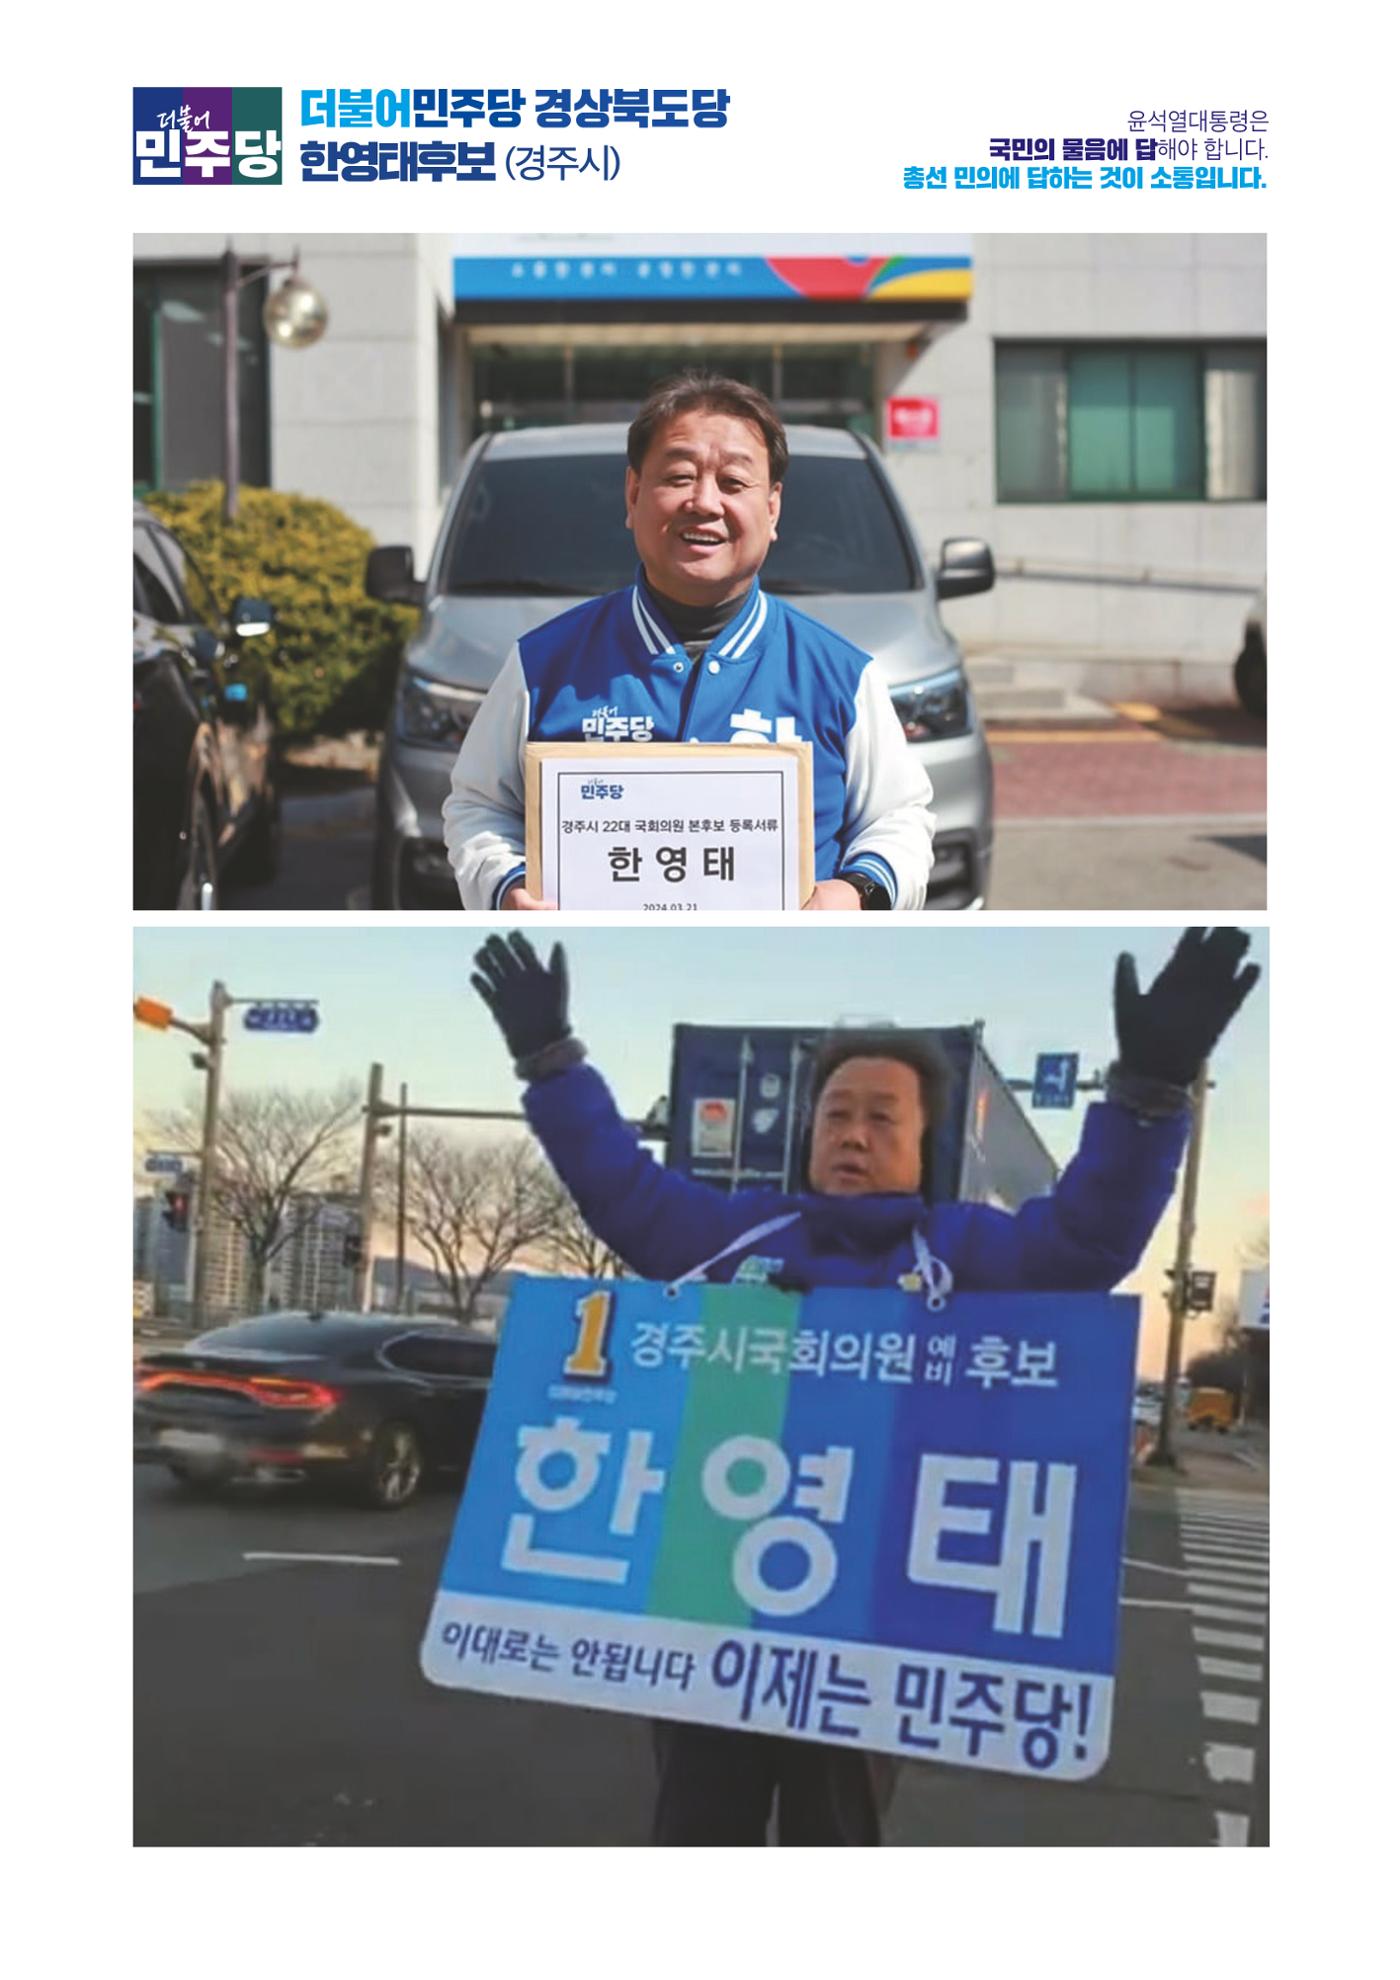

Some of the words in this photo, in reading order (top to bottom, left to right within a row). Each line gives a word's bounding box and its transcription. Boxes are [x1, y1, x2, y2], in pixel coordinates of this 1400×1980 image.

[582, 715, 655, 743] 민주당
[561, 819, 599, 834] 경주시
[602, 819, 631, 834] 22대
[634, 819, 685, 834] 국회의원
[688, 819, 726, 833] 본후보
[729, 818, 779, 833] 등록서류
[581, 784, 624, 800] 민주당
[562, 1290, 612, 1378] 1
[630, 1321, 917, 1384] 경주시국회의원
[965, 1335, 1058, 1389] 후보
[500, 1413, 1078, 1639] 한영태
[441, 1621, 560, 1673] 이대로는
[571, 1637, 696, 1692] 안됩니다
[711, 1639, 872, 1738] 이제는
[894, 1662, 1093, 1770] 민주당!
